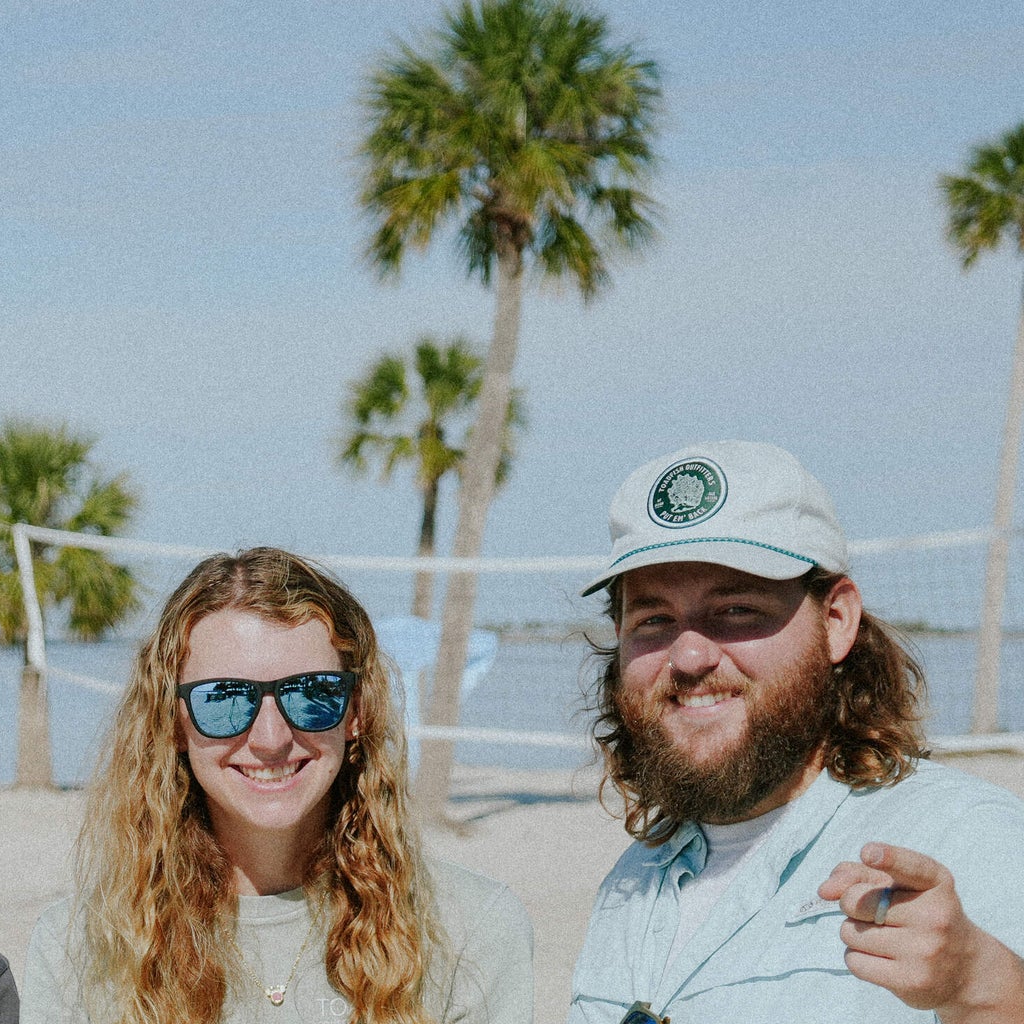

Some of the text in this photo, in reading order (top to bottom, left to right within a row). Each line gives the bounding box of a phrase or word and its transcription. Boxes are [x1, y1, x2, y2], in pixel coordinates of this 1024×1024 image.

[659, 464, 715, 493] TOADFISH OUTFITTERS
[660, 511, 673, 521] PUT
[688, 507, 708, 520] BACK
